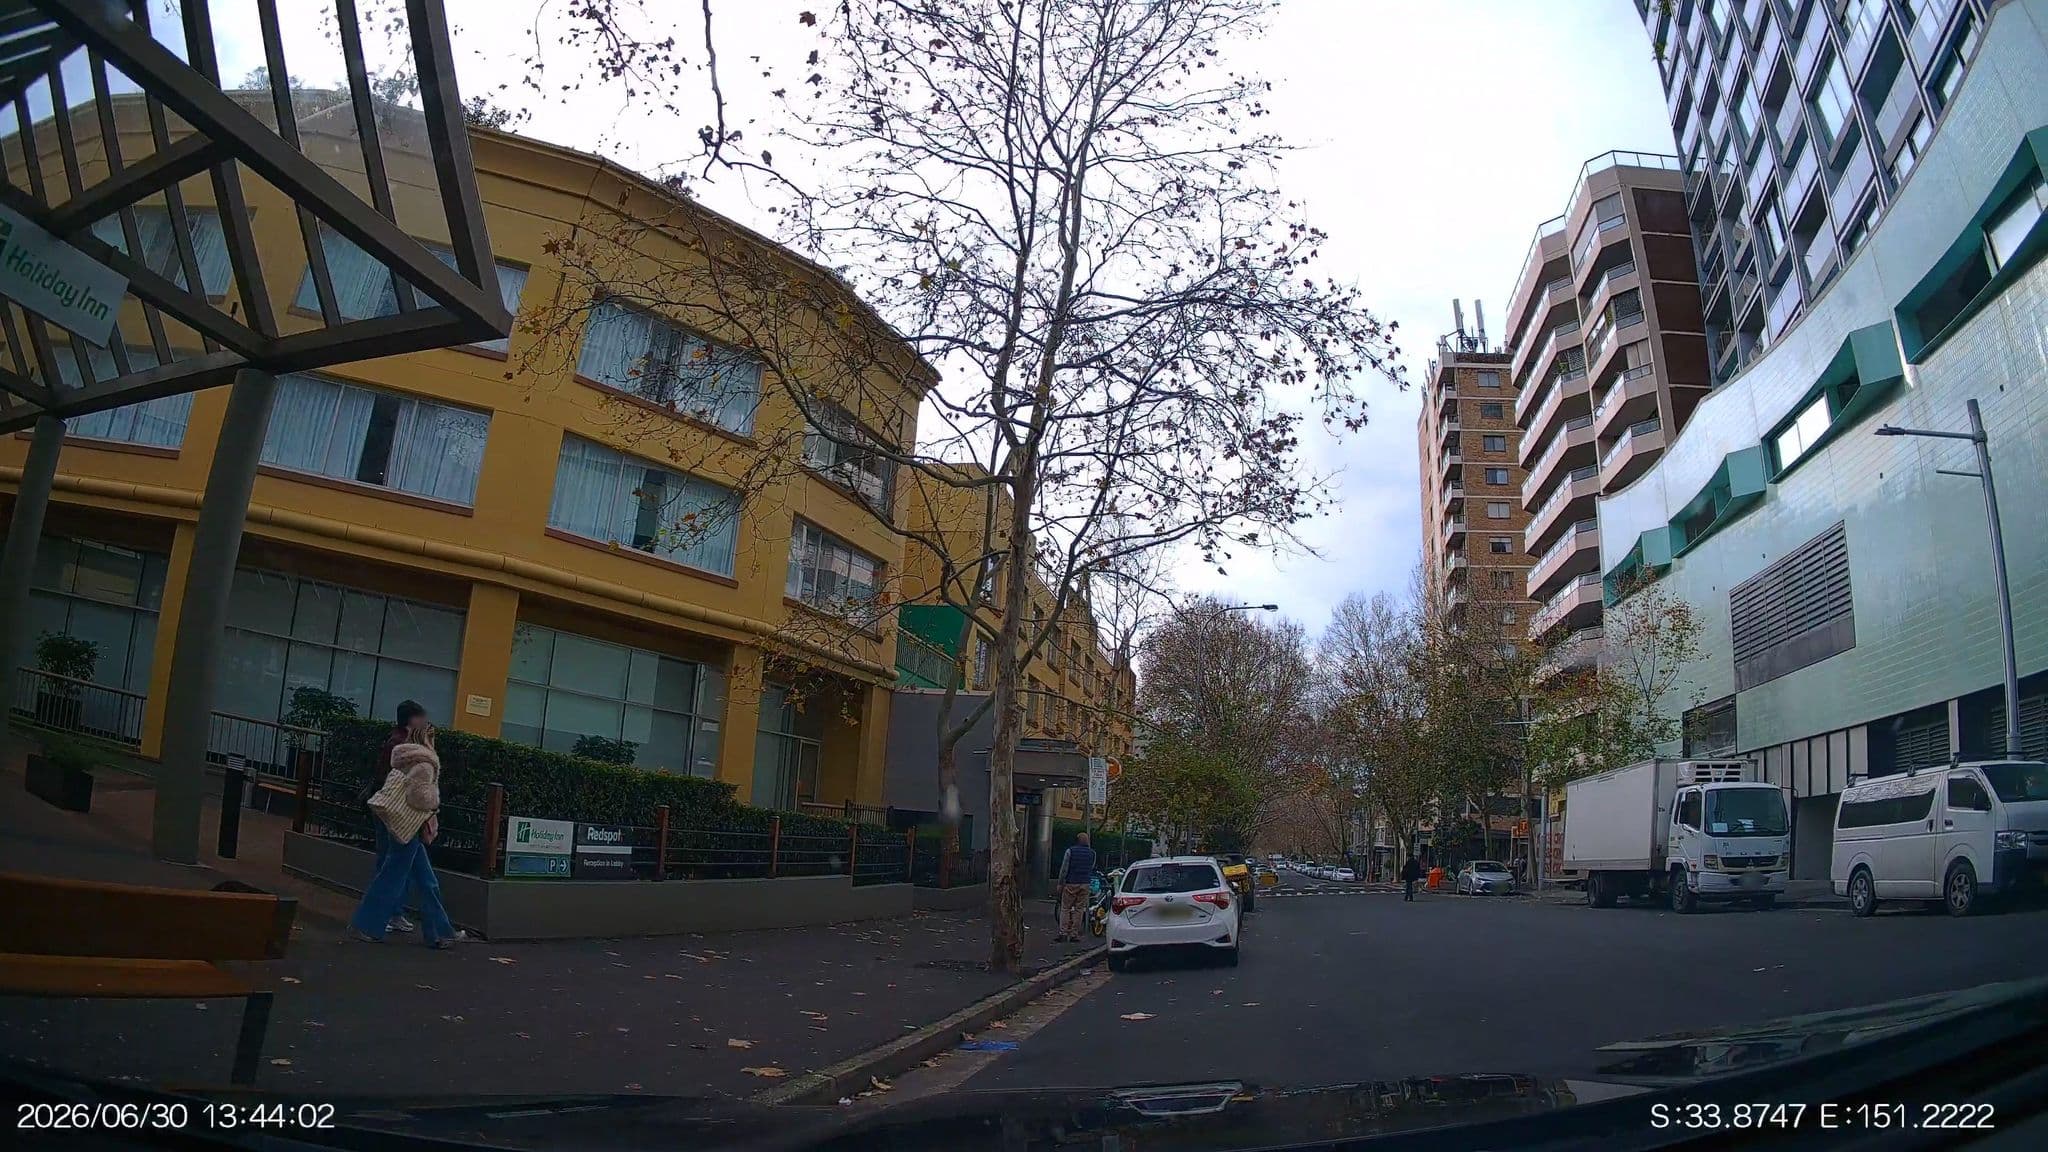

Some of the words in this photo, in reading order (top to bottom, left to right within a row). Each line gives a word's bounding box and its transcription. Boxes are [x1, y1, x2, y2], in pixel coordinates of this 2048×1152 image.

[6, 244, 79, 307] Holiday
[78, 286, 109, 320] Inn
[587, 827, 621, 844] Redspot
